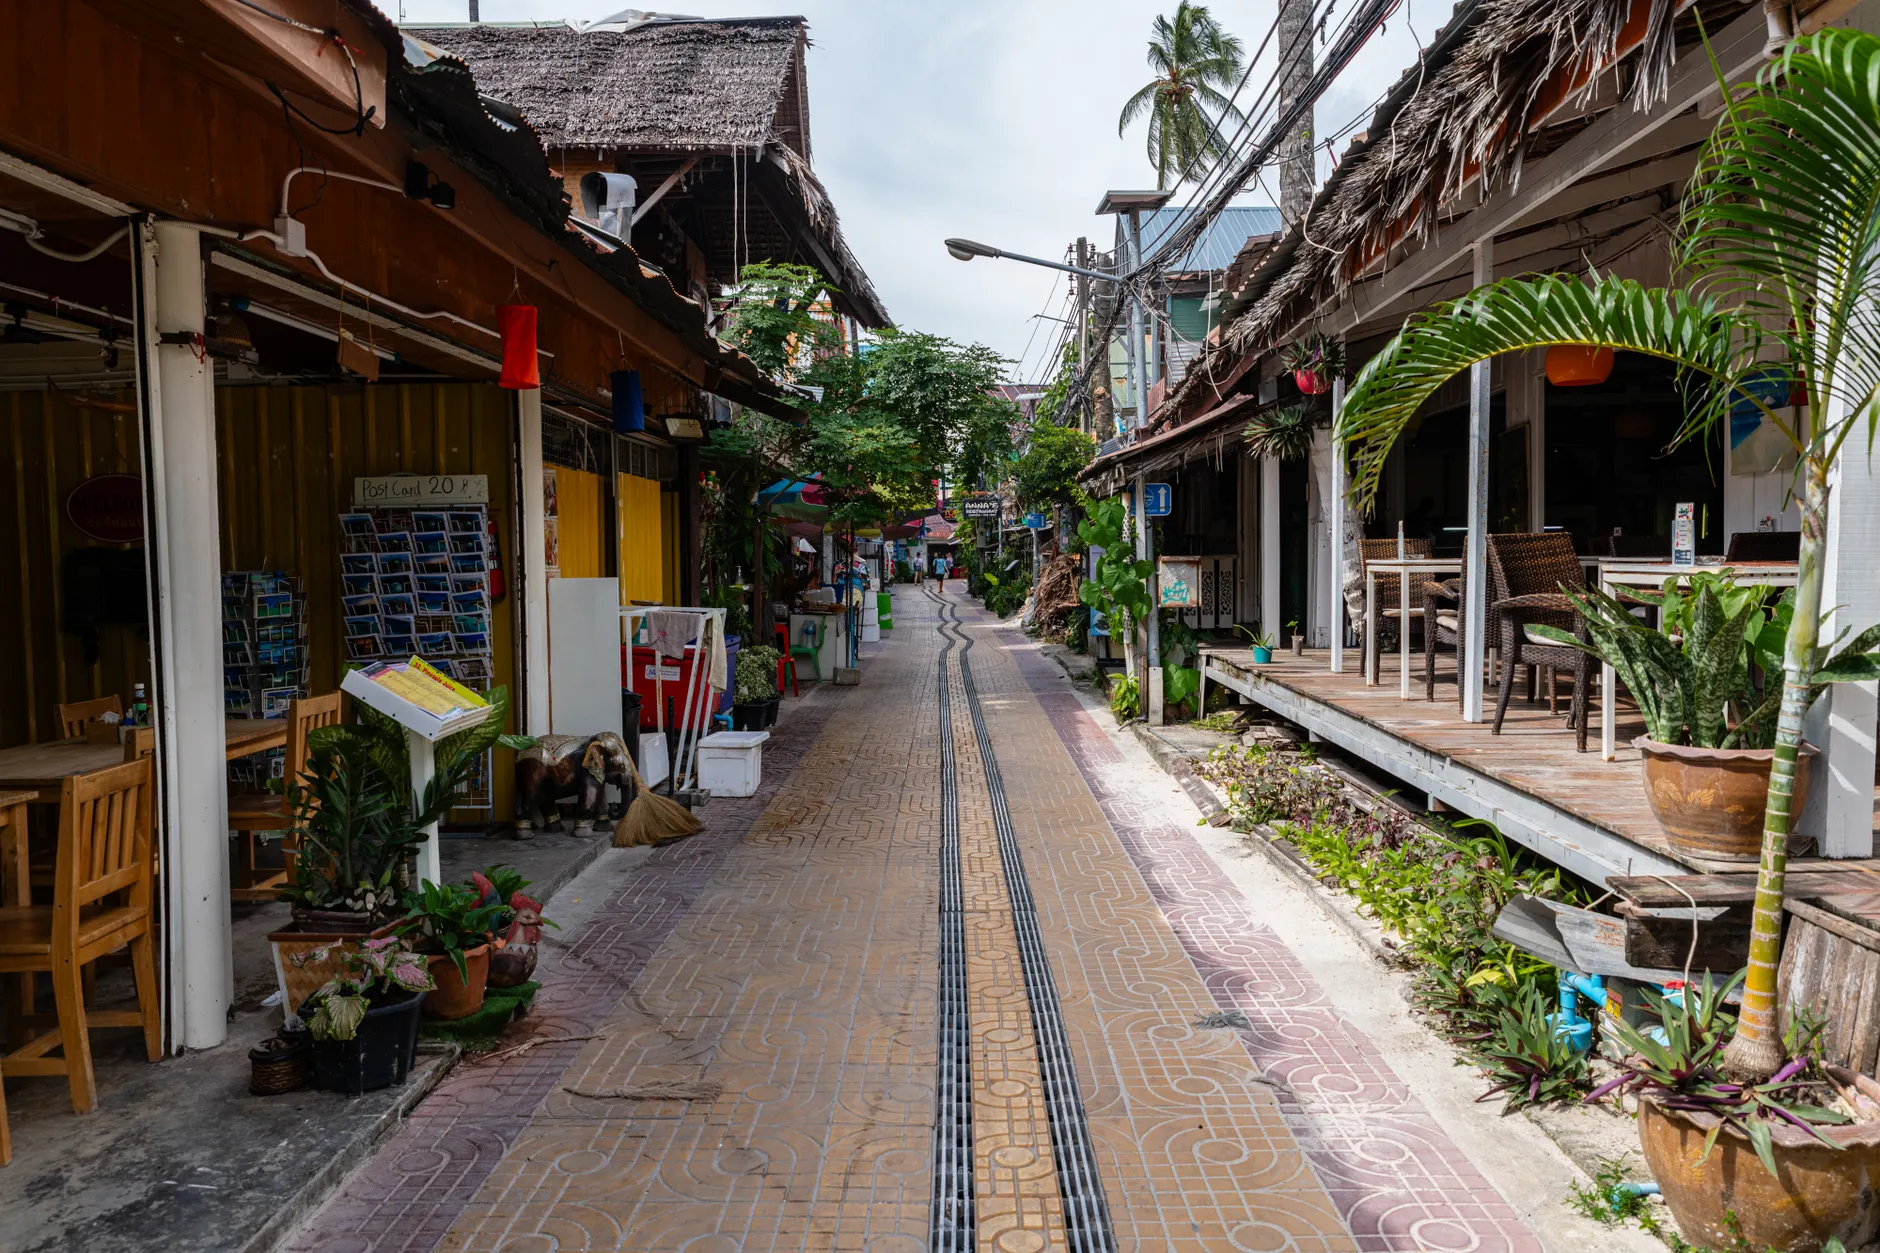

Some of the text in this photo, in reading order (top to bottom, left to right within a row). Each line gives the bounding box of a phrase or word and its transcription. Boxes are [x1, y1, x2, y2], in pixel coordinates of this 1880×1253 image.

[362, 479, 388, 499] Post
[392, 480, 422, 497] Card
[429, 477, 454, 494] 20
